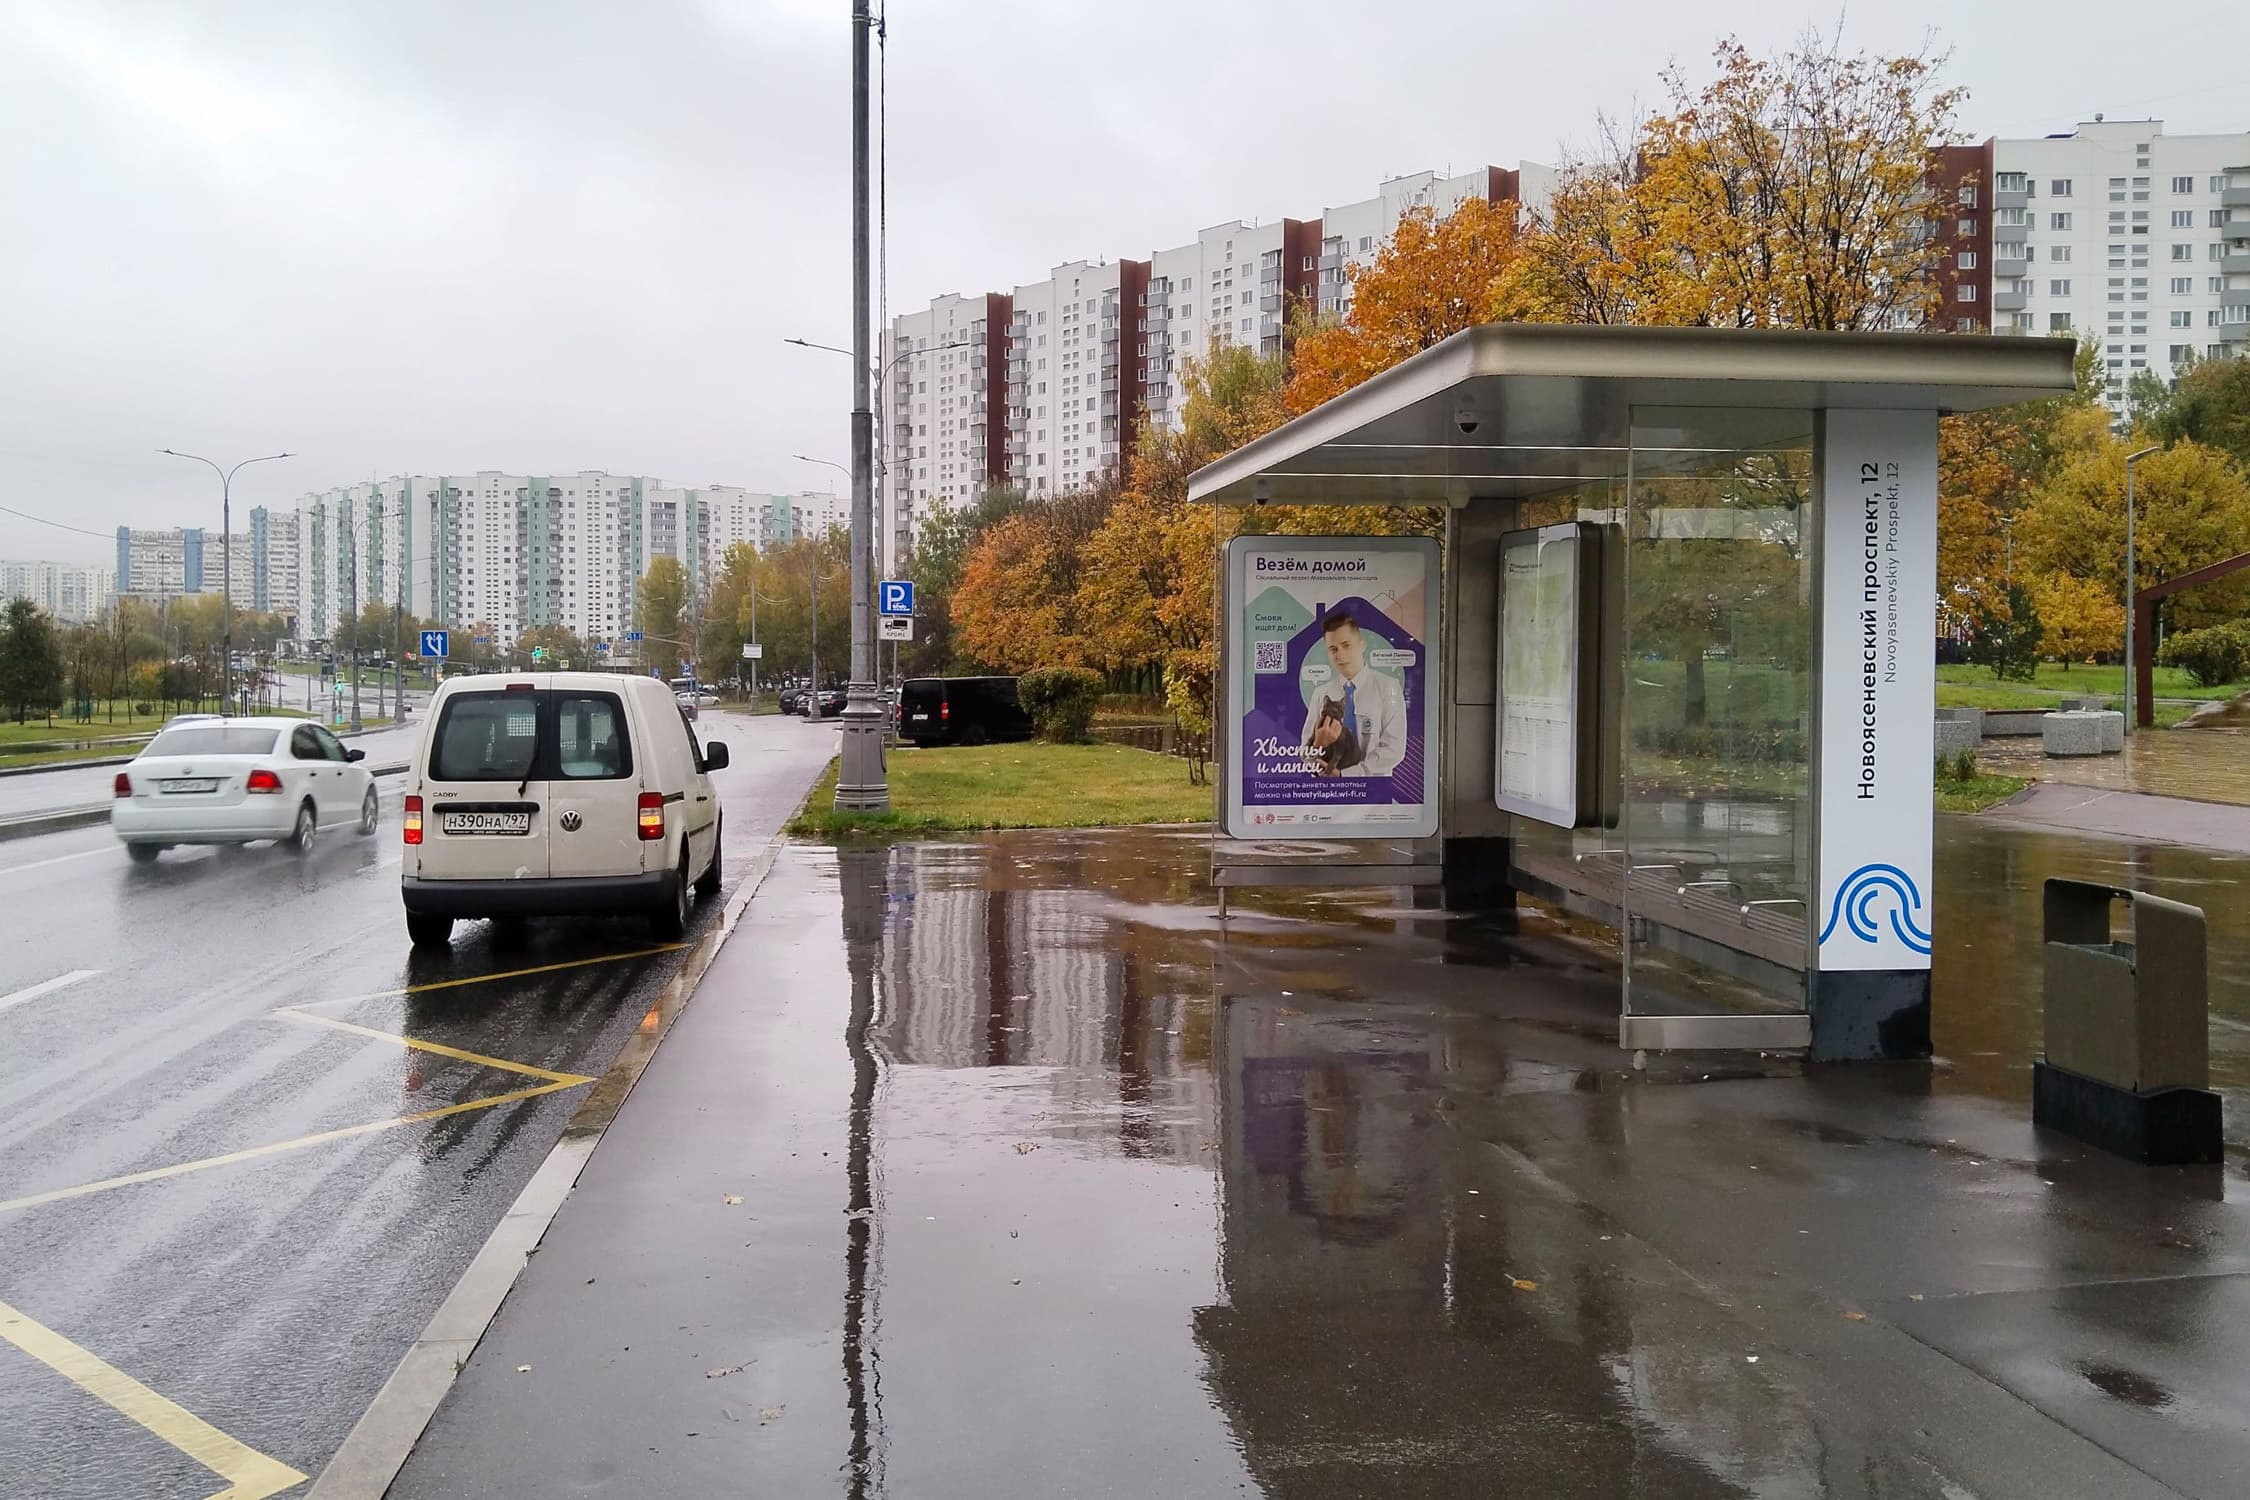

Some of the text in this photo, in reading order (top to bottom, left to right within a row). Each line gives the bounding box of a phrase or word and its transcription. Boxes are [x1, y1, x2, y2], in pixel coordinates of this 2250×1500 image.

[1256, 556, 1366, 573] Везём домой
[1884, 462, 1900, 682] Novoyasenevskiy Prospekt, 12
[1255, 613, 1282, 621] Смоки
[1255, 624, 1297, 633] ищет дом!
[1857, 462, 1881, 799] Новоясеневский проспект, 12
[1253, 736, 1326, 757] Хвосты
[1257, 762, 1324, 774] и лапки
[504, 815, 525, 825] 797
